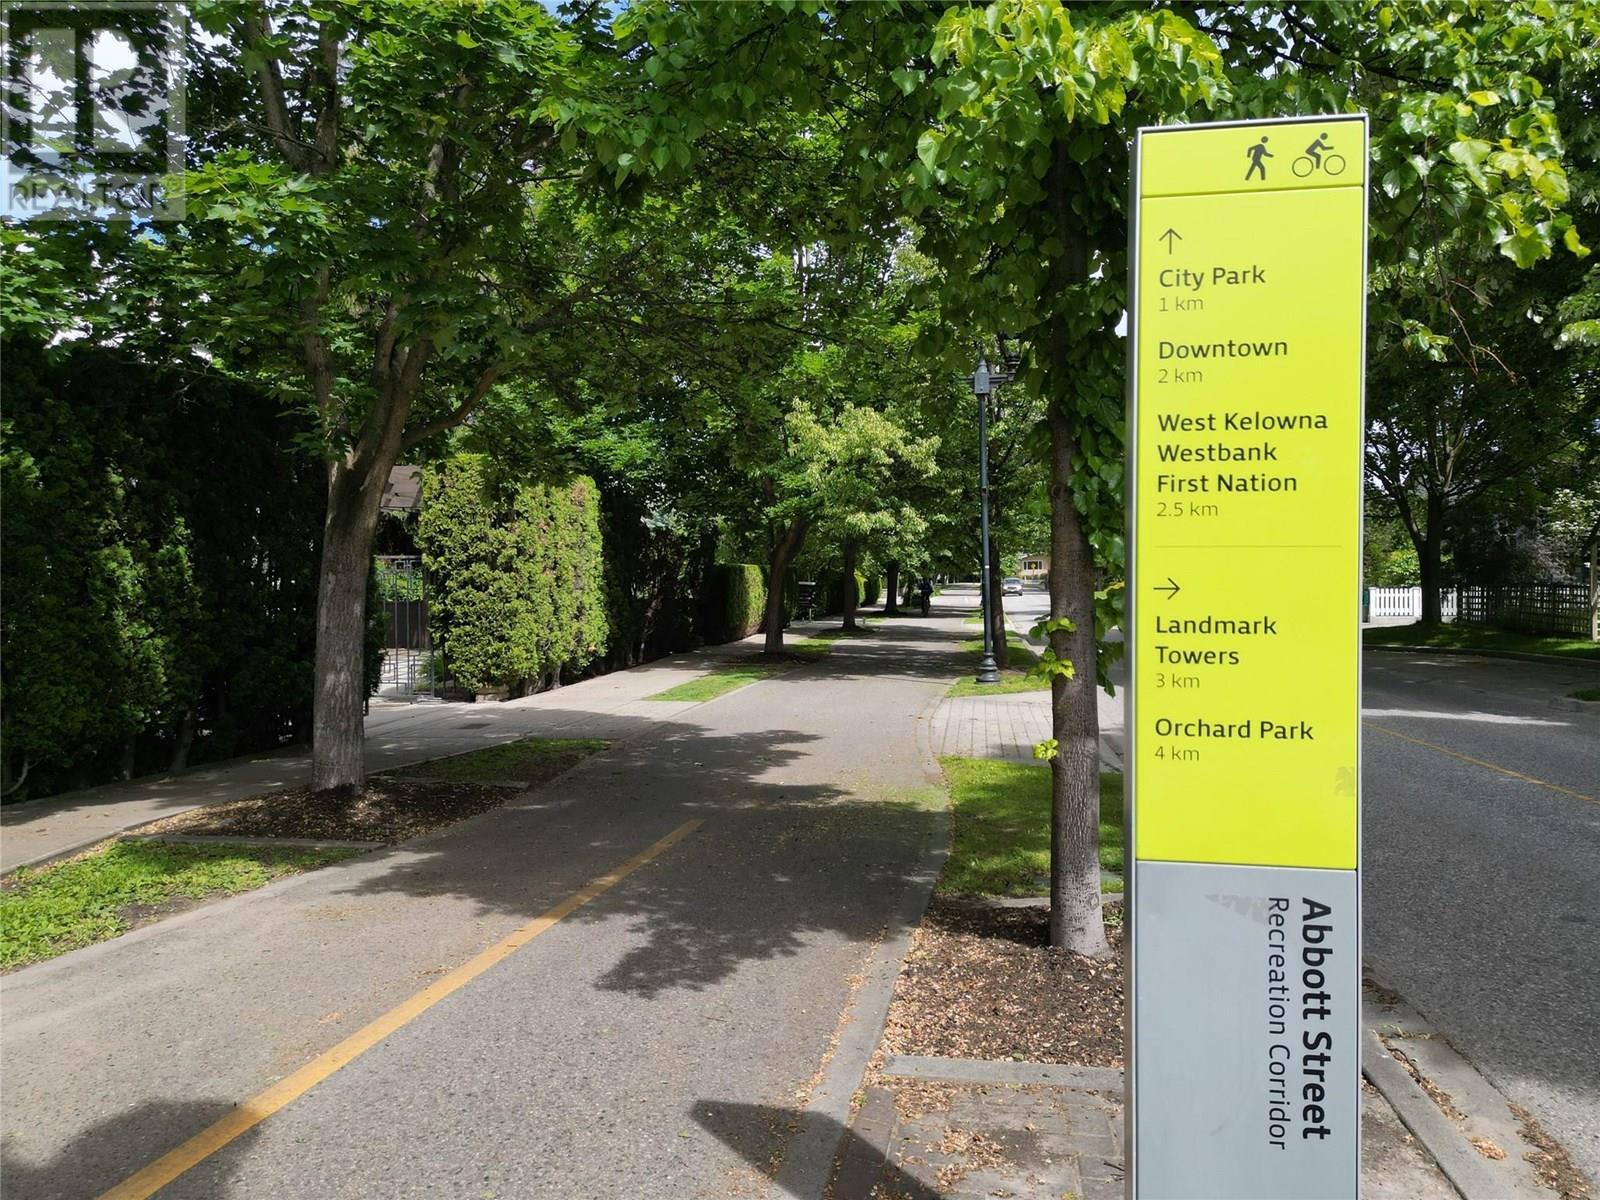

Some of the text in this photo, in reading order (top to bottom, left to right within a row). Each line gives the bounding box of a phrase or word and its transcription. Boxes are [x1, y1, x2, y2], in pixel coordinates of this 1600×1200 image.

[1158, 264, 1265, 290] City Park
[1159, 296, 1203, 311] 1 km
[1158, 339, 1287, 359] Downtown
[1157, 368, 1203, 383] 2 km
[1157, 411, 1328, 432] West Kelowna
[1157, 441, 1278, 462] Westbank
[1157, 473, 1297, 493] First Nation
[1156, 501, 1218, 517] 2.5 km
[1155, 615, 1277, 635] Landmark
[1153, 645, 1239, 665] Towers
[1155, 673, 1199, 688] 3 km
[1154, 717, 1314, 740] Orchard Park
[1154, 745, 1199, 760] 4 km
[1267, 897, 1291, 1150] Recreation Corridor
[1301, 896, 1333, 1140] Abbott Street
